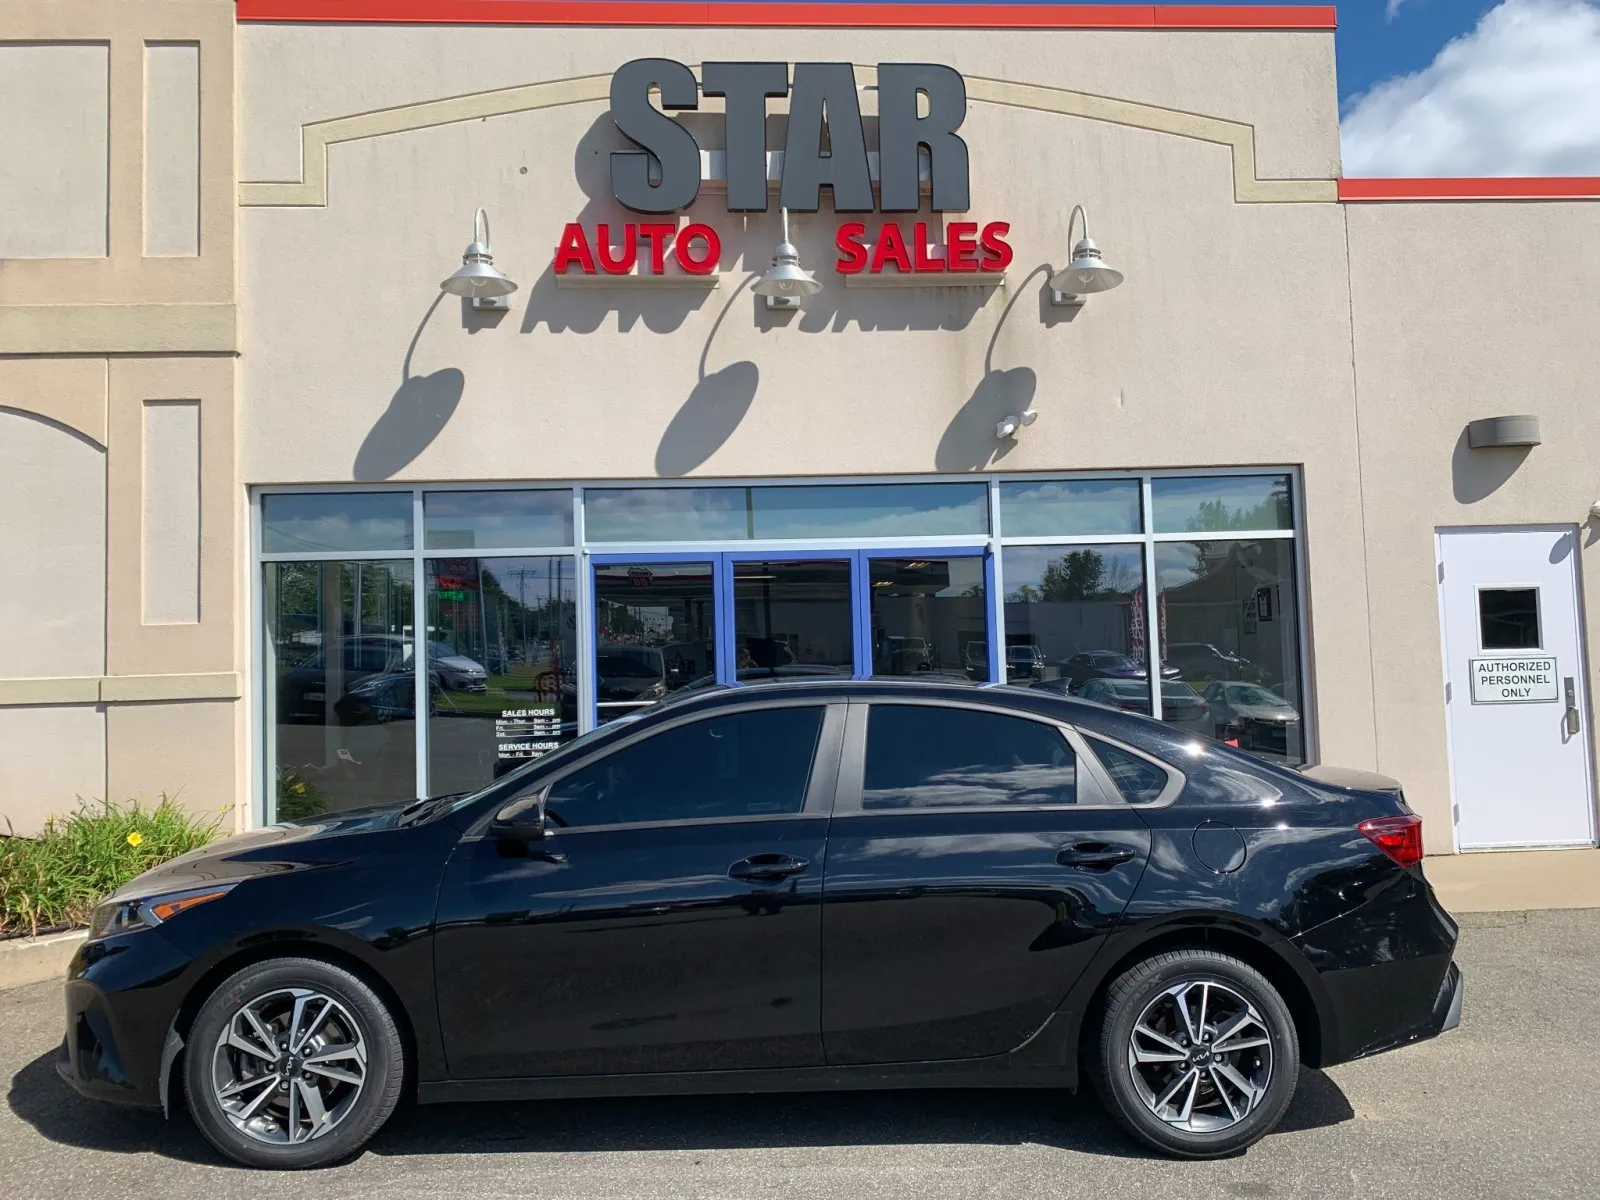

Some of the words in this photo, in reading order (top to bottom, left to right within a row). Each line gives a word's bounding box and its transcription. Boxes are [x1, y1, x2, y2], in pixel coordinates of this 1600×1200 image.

[610, 57, 970, 213] STAR
[553, 222, 722, 276] AUTO
[835, 221, 1014, 275] SALES
[1478, 661, 1551, 673] AUTHORIZED
[1481, 674, 1551, 686] PERSONNEL
[1501, 687, 1532, 698] ONLY
[502, 709, 527, 718] SALES
[528, 708, 555, 717] HOURS
[498, 743, 531, 751] SERVICE
[532, 741, 559, 750] HOURS
